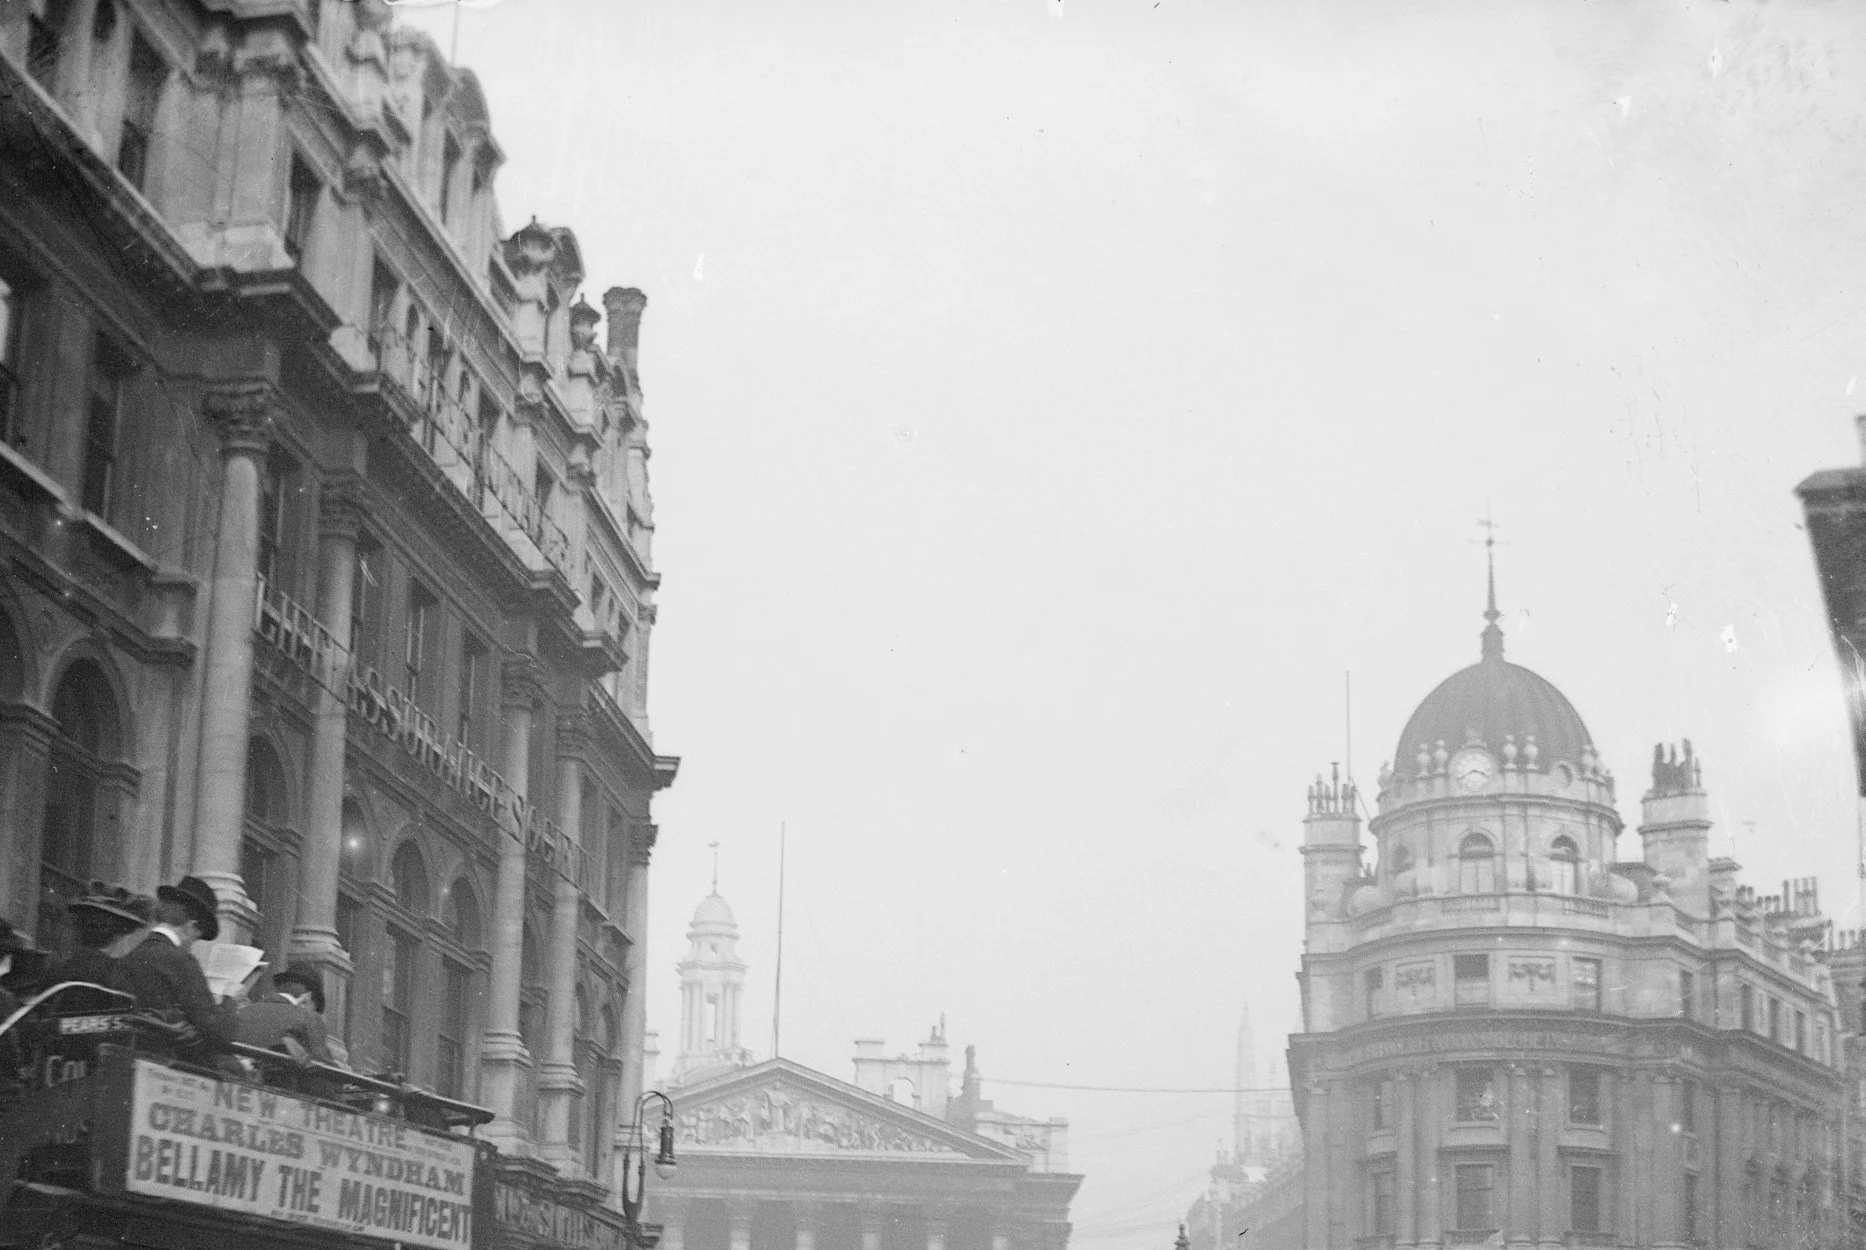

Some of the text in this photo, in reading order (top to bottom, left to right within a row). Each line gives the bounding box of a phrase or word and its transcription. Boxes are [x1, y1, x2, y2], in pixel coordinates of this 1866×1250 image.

[150, 1102, 304, 1159] CHARLES
[317, 1139, 466, 1197] WYNDHAM
[213, 1081, 276, 1120] NEW
[302, 1101, 407, 1149] THEATRE
[135, 1134, 265, 1202] BELLAMY
[279, 1164, 322, 1214] THE
[337, 1178, 472, 1244] MAGNIFICENT
